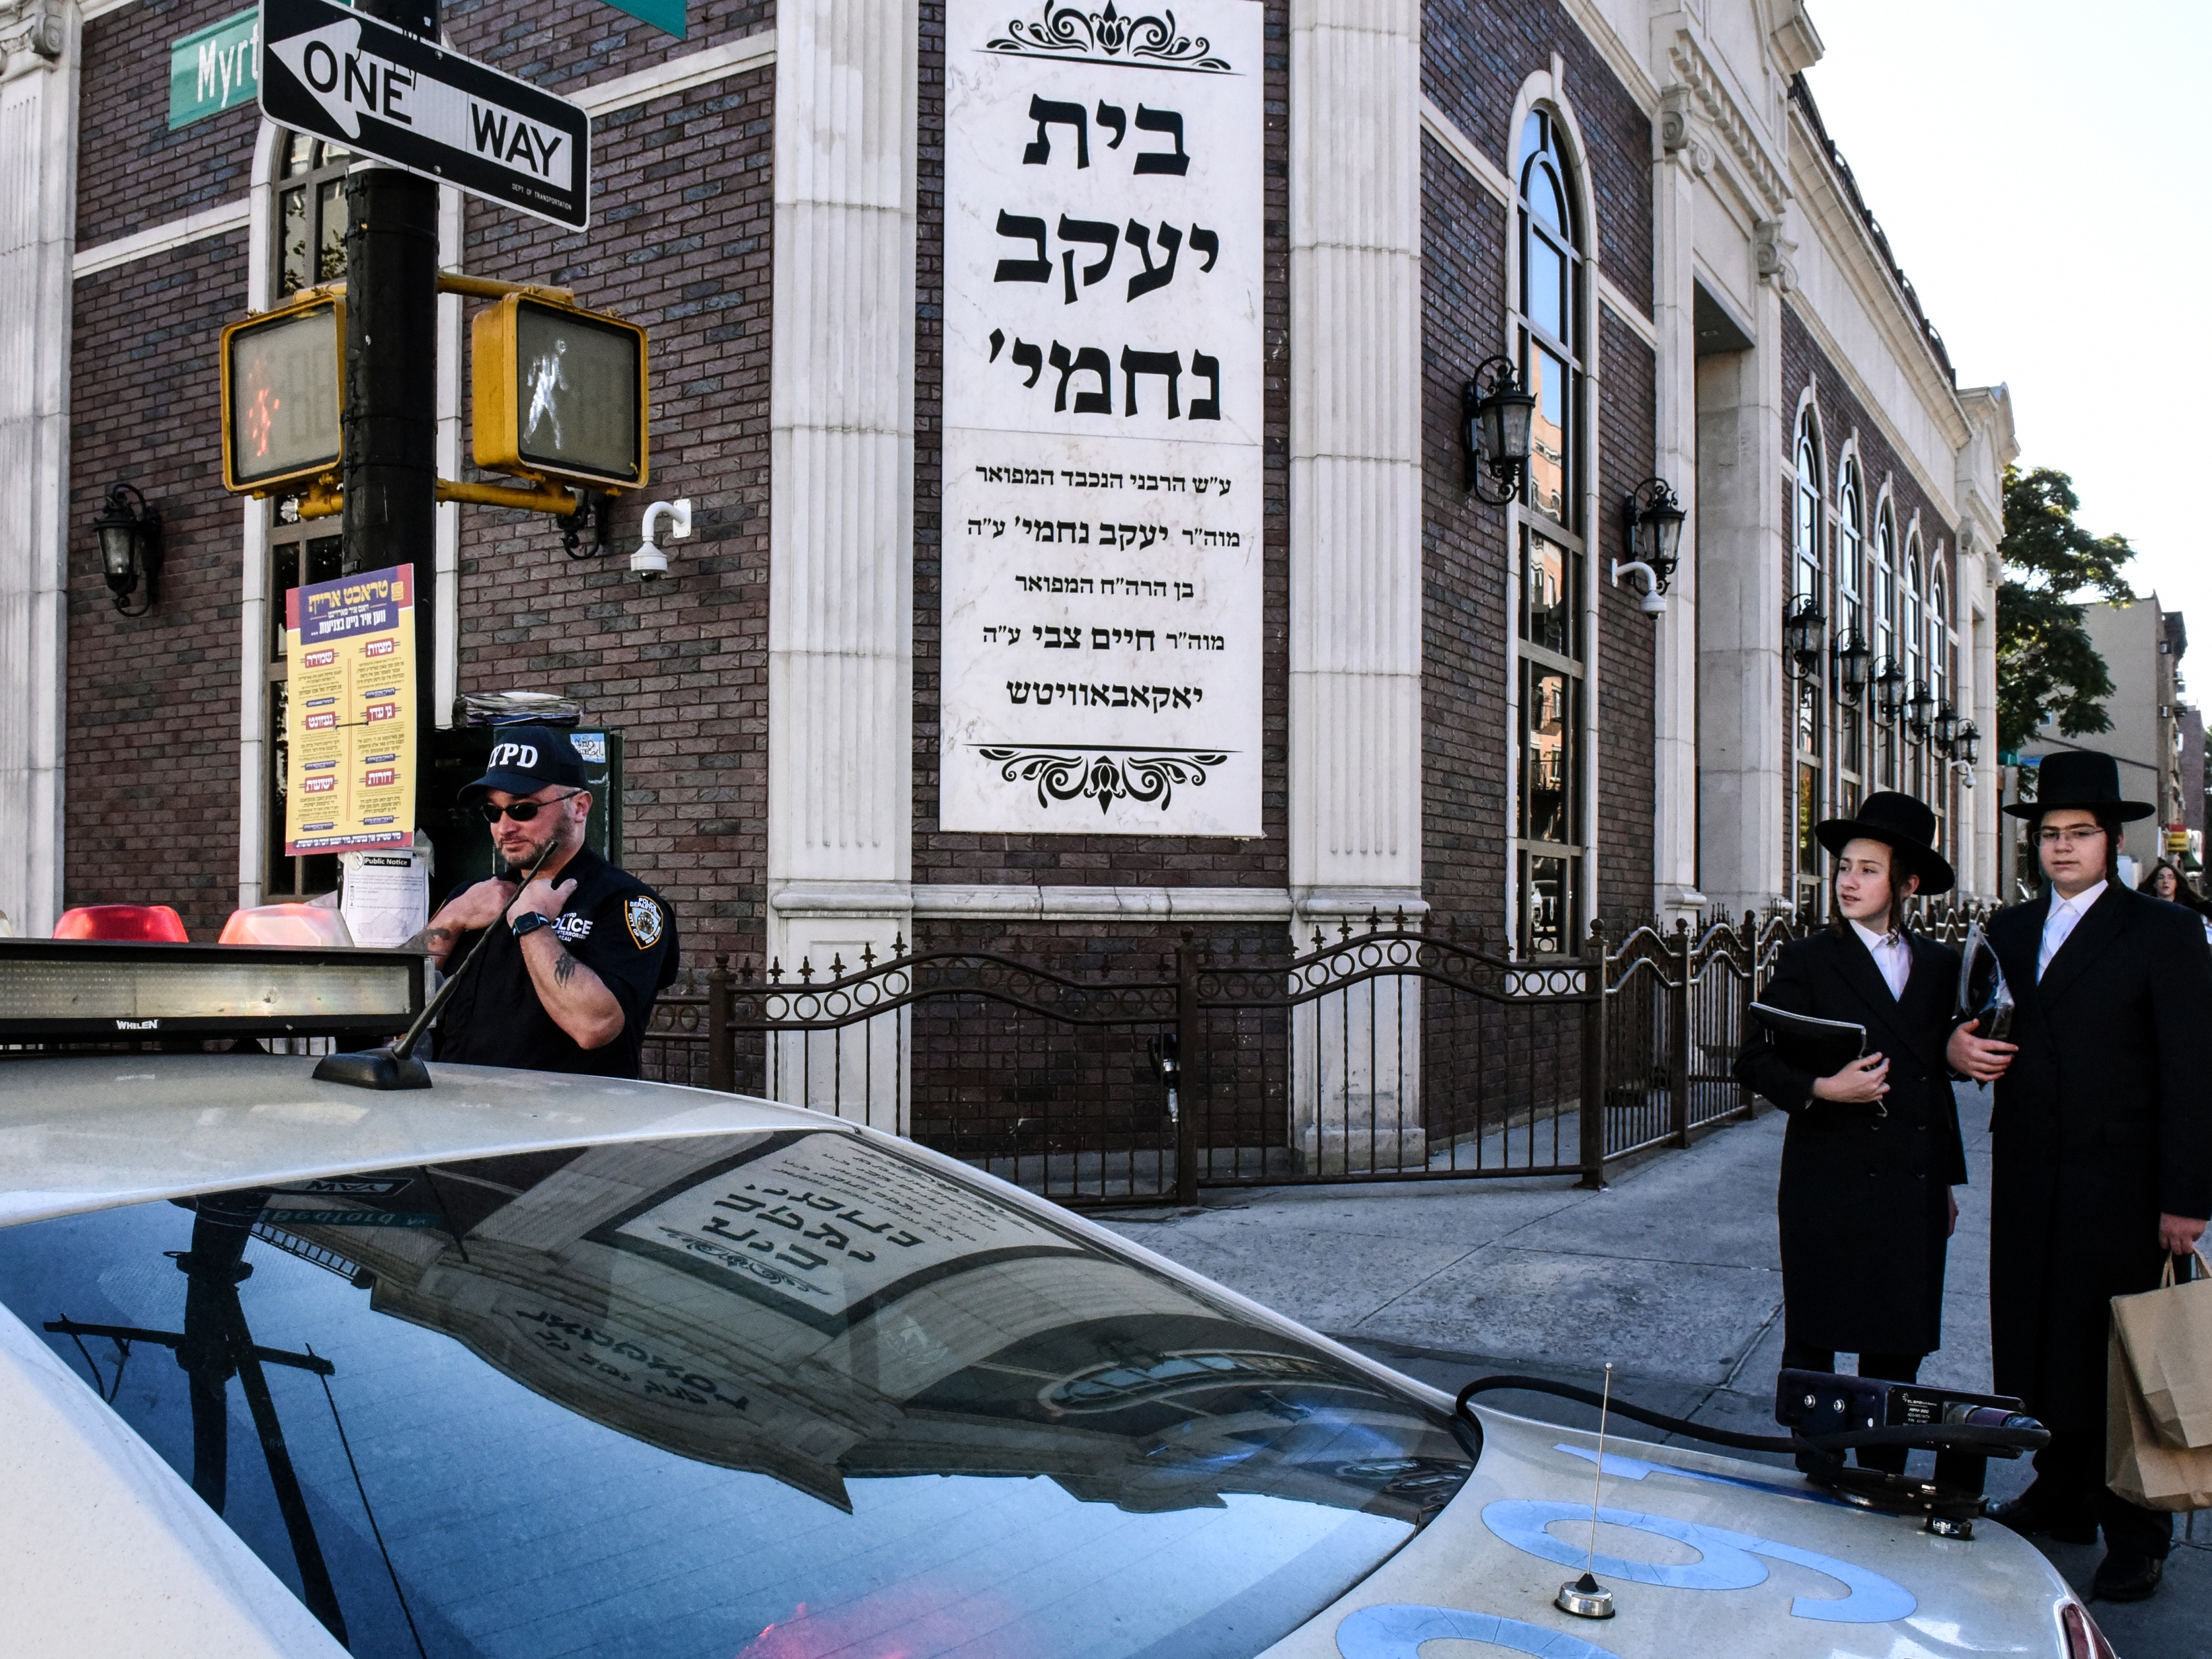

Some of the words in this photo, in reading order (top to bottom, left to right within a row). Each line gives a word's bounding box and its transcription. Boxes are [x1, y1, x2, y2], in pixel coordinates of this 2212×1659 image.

[197, 22, 260, 108] Myrt
[303, 40, 414, 126] ONE
[470, 102, 563, 178] WAY
[1023, 94, 1190, 176] בית
[512, 183, 524, 193] DEPT
[534, 191, 572, 211] TRANSPORTATION
[994, 209, 1218, 305] יעקב
[975, 466, 1054, 485] המפואר
[1061, 471, 1123, 488] הנכבד
[1130, 474, 1185, 492] הרבני
[1099, 523, 1168, 551] יעקב
[1015, 575, 1093, 593] המפואר
[1174, 582, 1193, 601] בן
[1033, 625, 1081, 649] צבי
[1092, 627, 1155, 651] חיים
[1006, 681, 1202, 713] יאקאבאוויטש
[486, 743, 538, 772] YPD
[365, 857, 385, 865] Public
[386, 858, 408, 866] Notice
[638, 897, 657, 910] POLICE
[551, 917, 593, 934] OLICE
[116, 1019, 159, 1030] WHELEN
